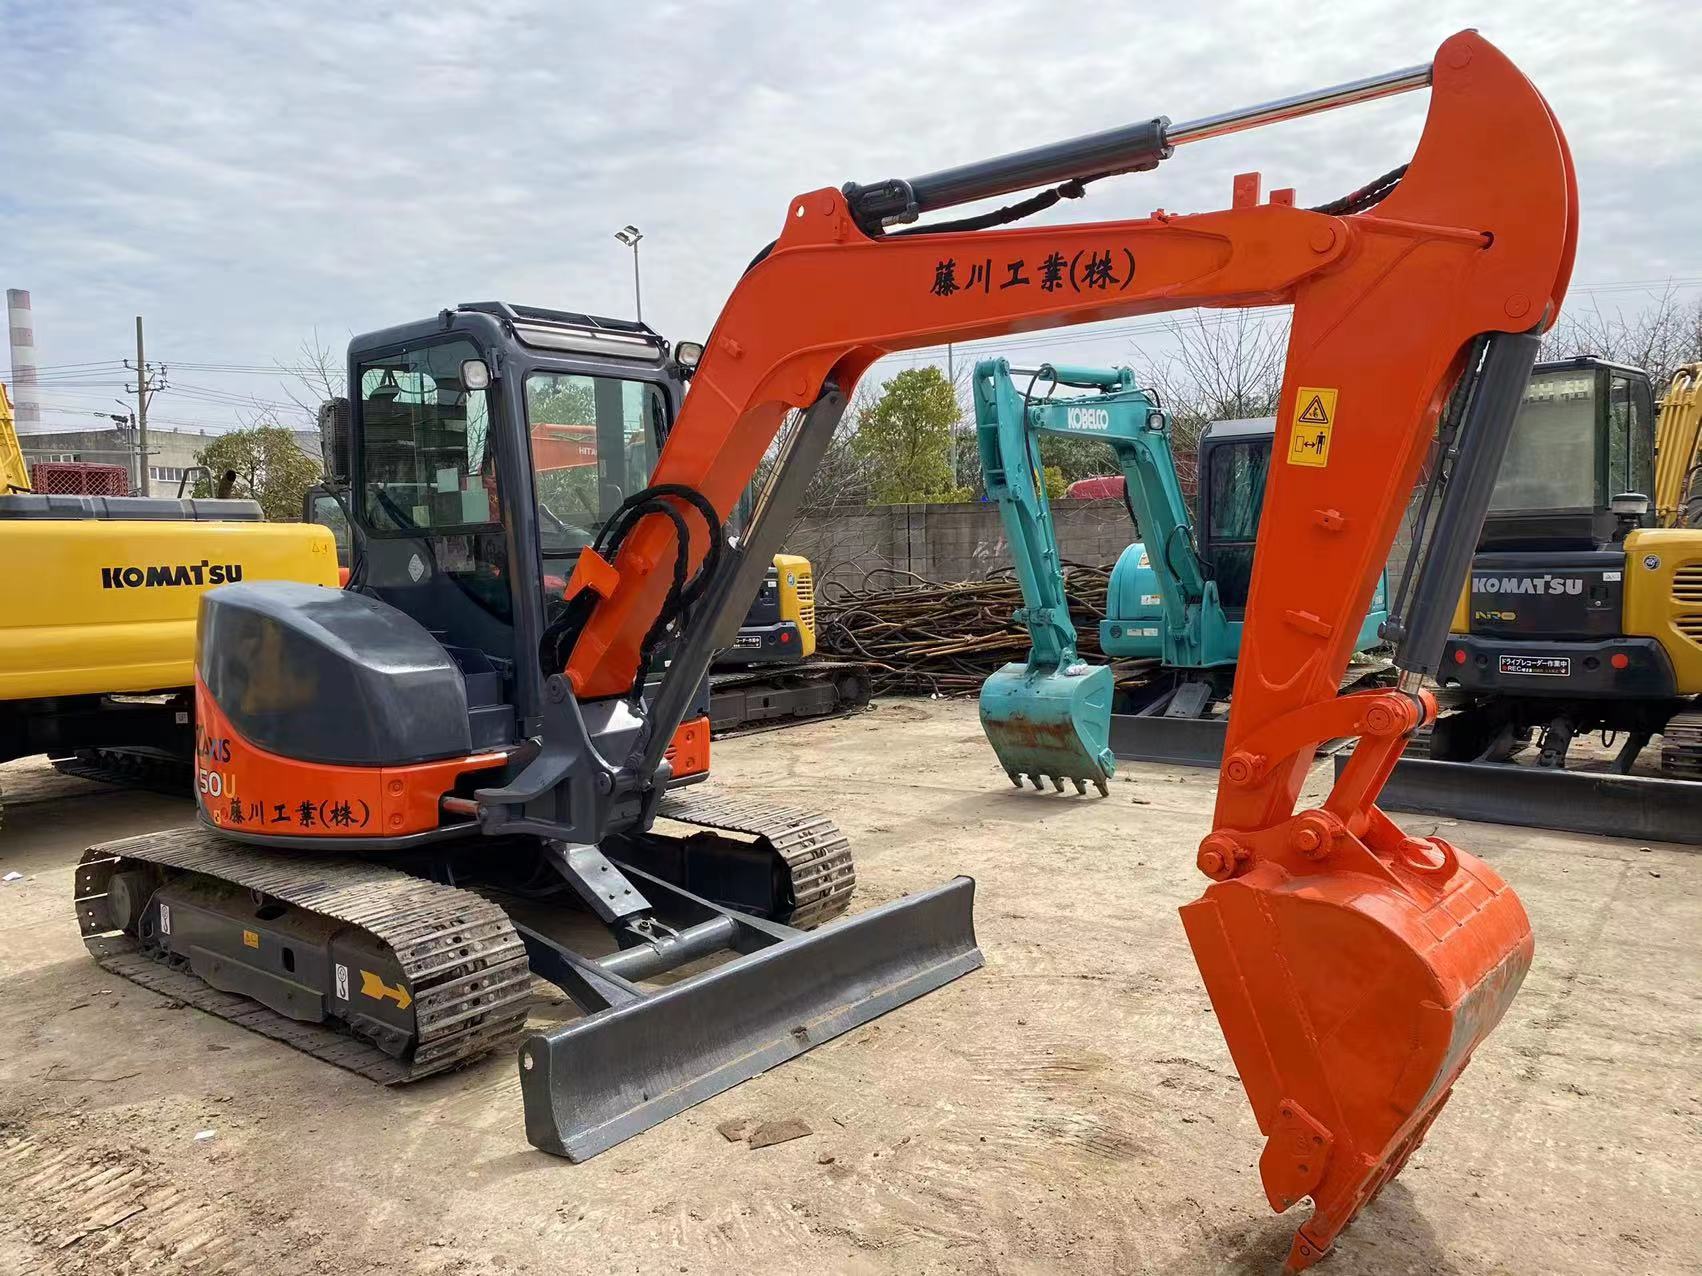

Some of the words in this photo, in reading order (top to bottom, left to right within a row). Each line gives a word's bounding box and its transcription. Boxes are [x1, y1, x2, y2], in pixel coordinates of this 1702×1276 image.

[930, 247, 1136, 296] 藤川工業(株)
[1068, 407, 1109, 430] KOBELCO
[102, 560, 242, 588] KOMATSU
[1472, 575, 1583, 595] KOMATSU
